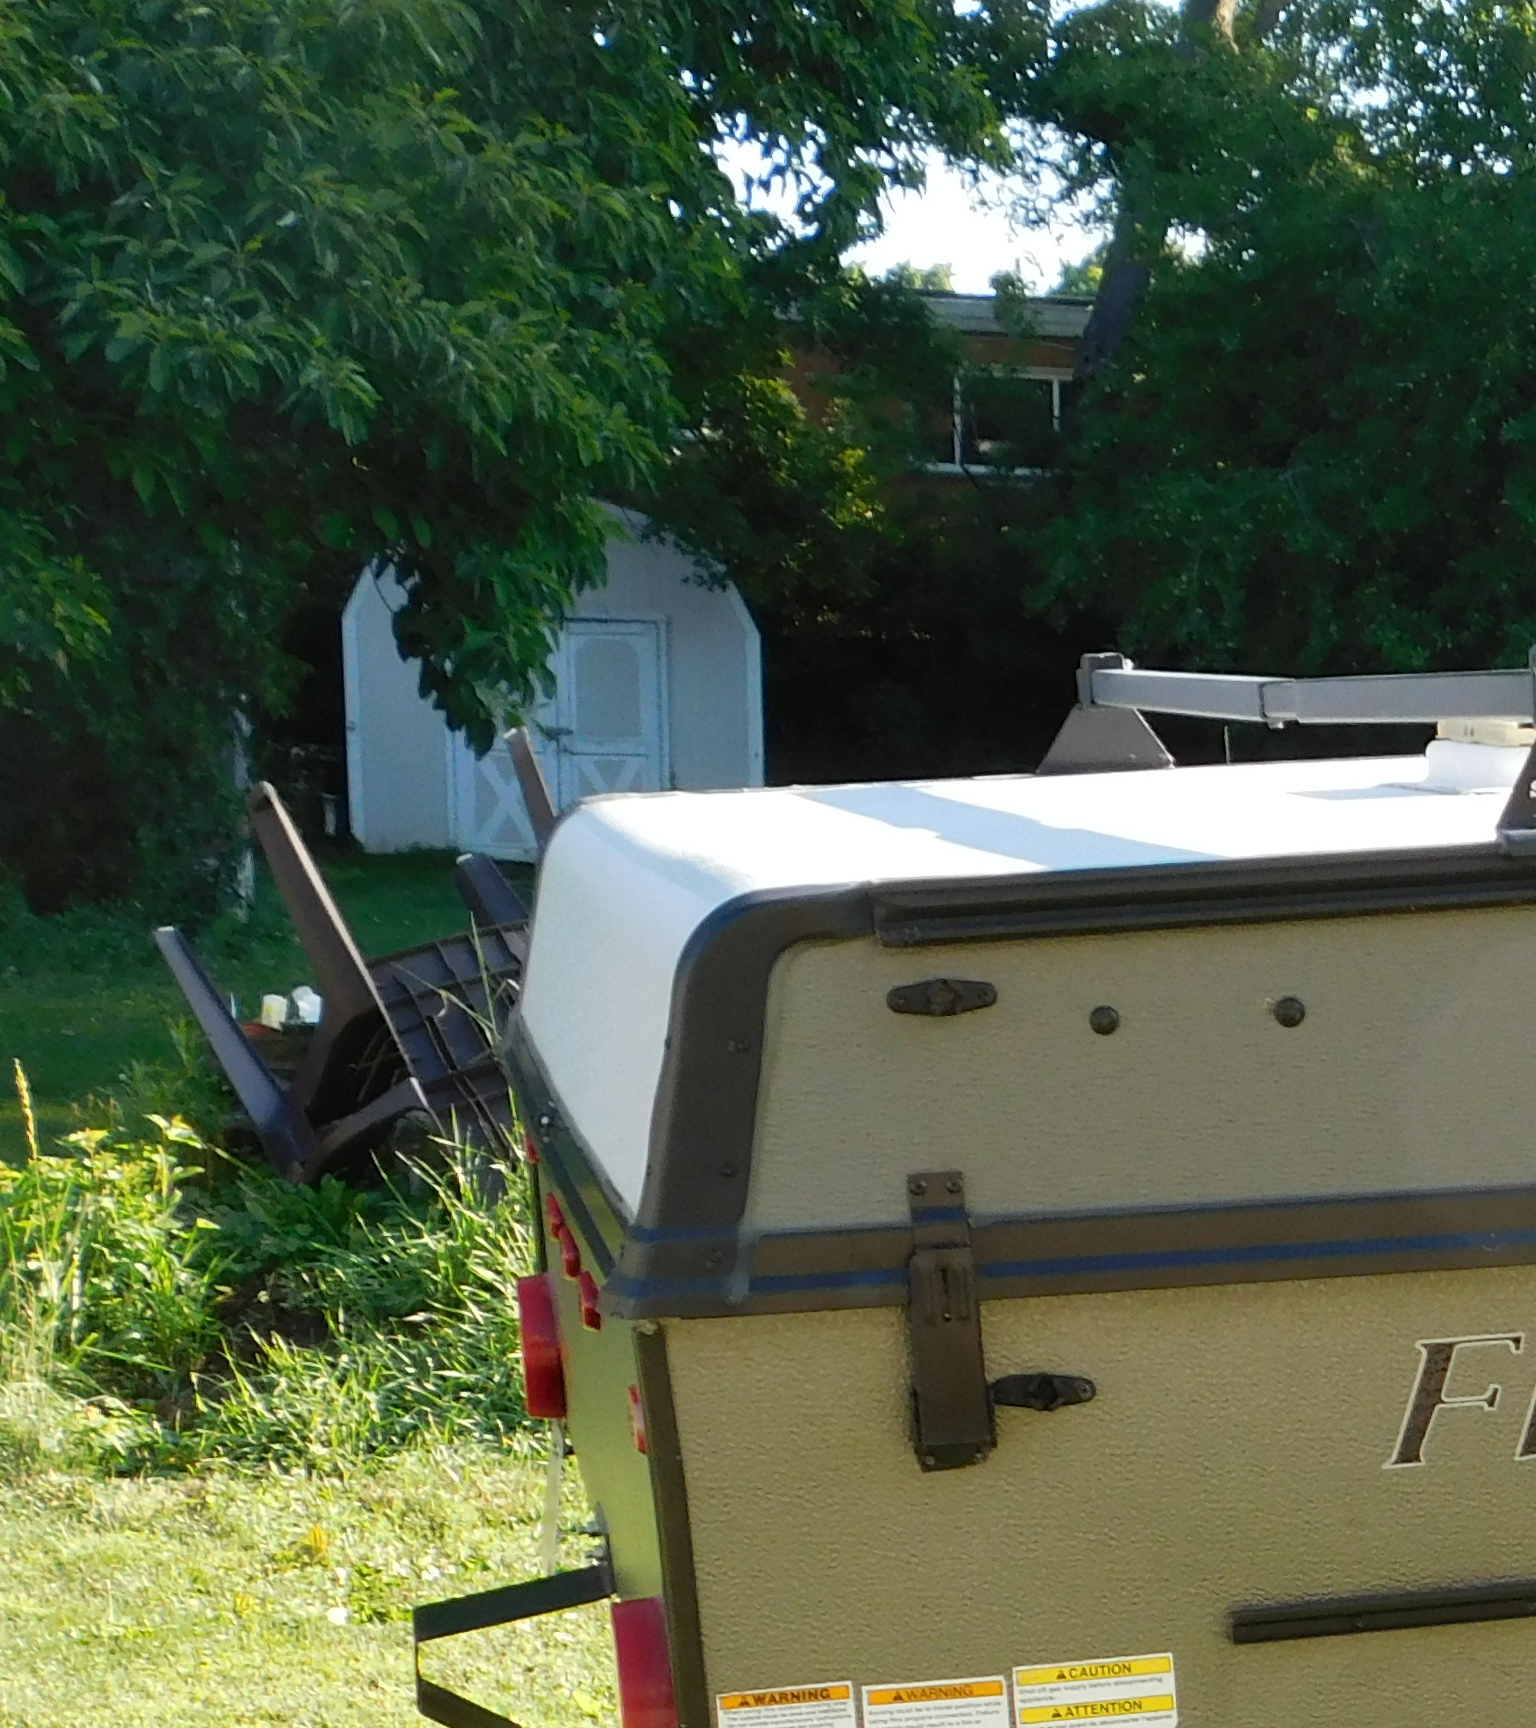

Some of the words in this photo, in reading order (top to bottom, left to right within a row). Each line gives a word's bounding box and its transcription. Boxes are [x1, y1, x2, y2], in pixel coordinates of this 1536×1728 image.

[1069, 1662, 1132, 1679] CAUTION
[753, 1688, 831, 1706] WARNING
[904, 1685, 974, 1701] WARNING
[1065, 1700, 1142, 1717] ATTENTION
